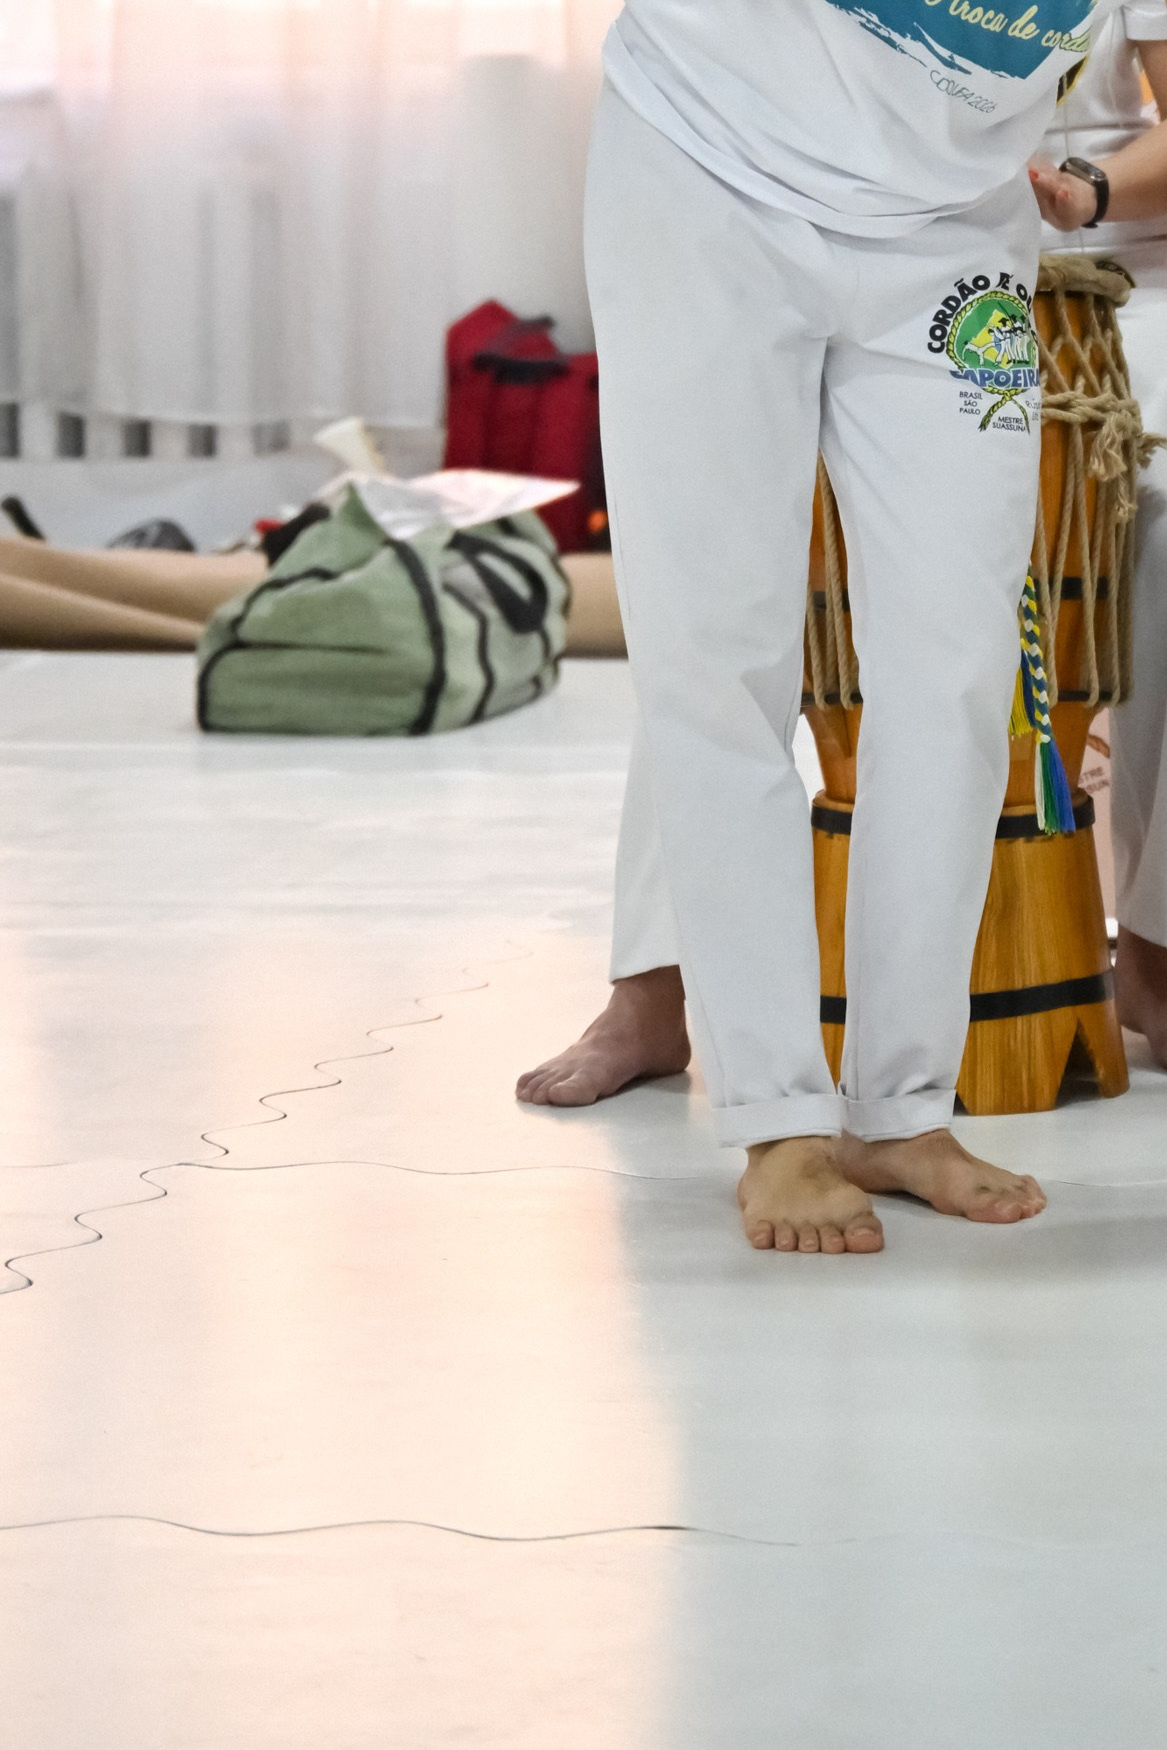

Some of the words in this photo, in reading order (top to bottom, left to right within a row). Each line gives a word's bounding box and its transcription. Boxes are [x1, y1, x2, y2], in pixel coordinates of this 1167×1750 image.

[1008, 5, 1039, 40] de
[927, 274, 991, 354] CORDÃO
[959, 391, 983, 400] BRASIL
[998, 416, 1023, 424] MESTRE
